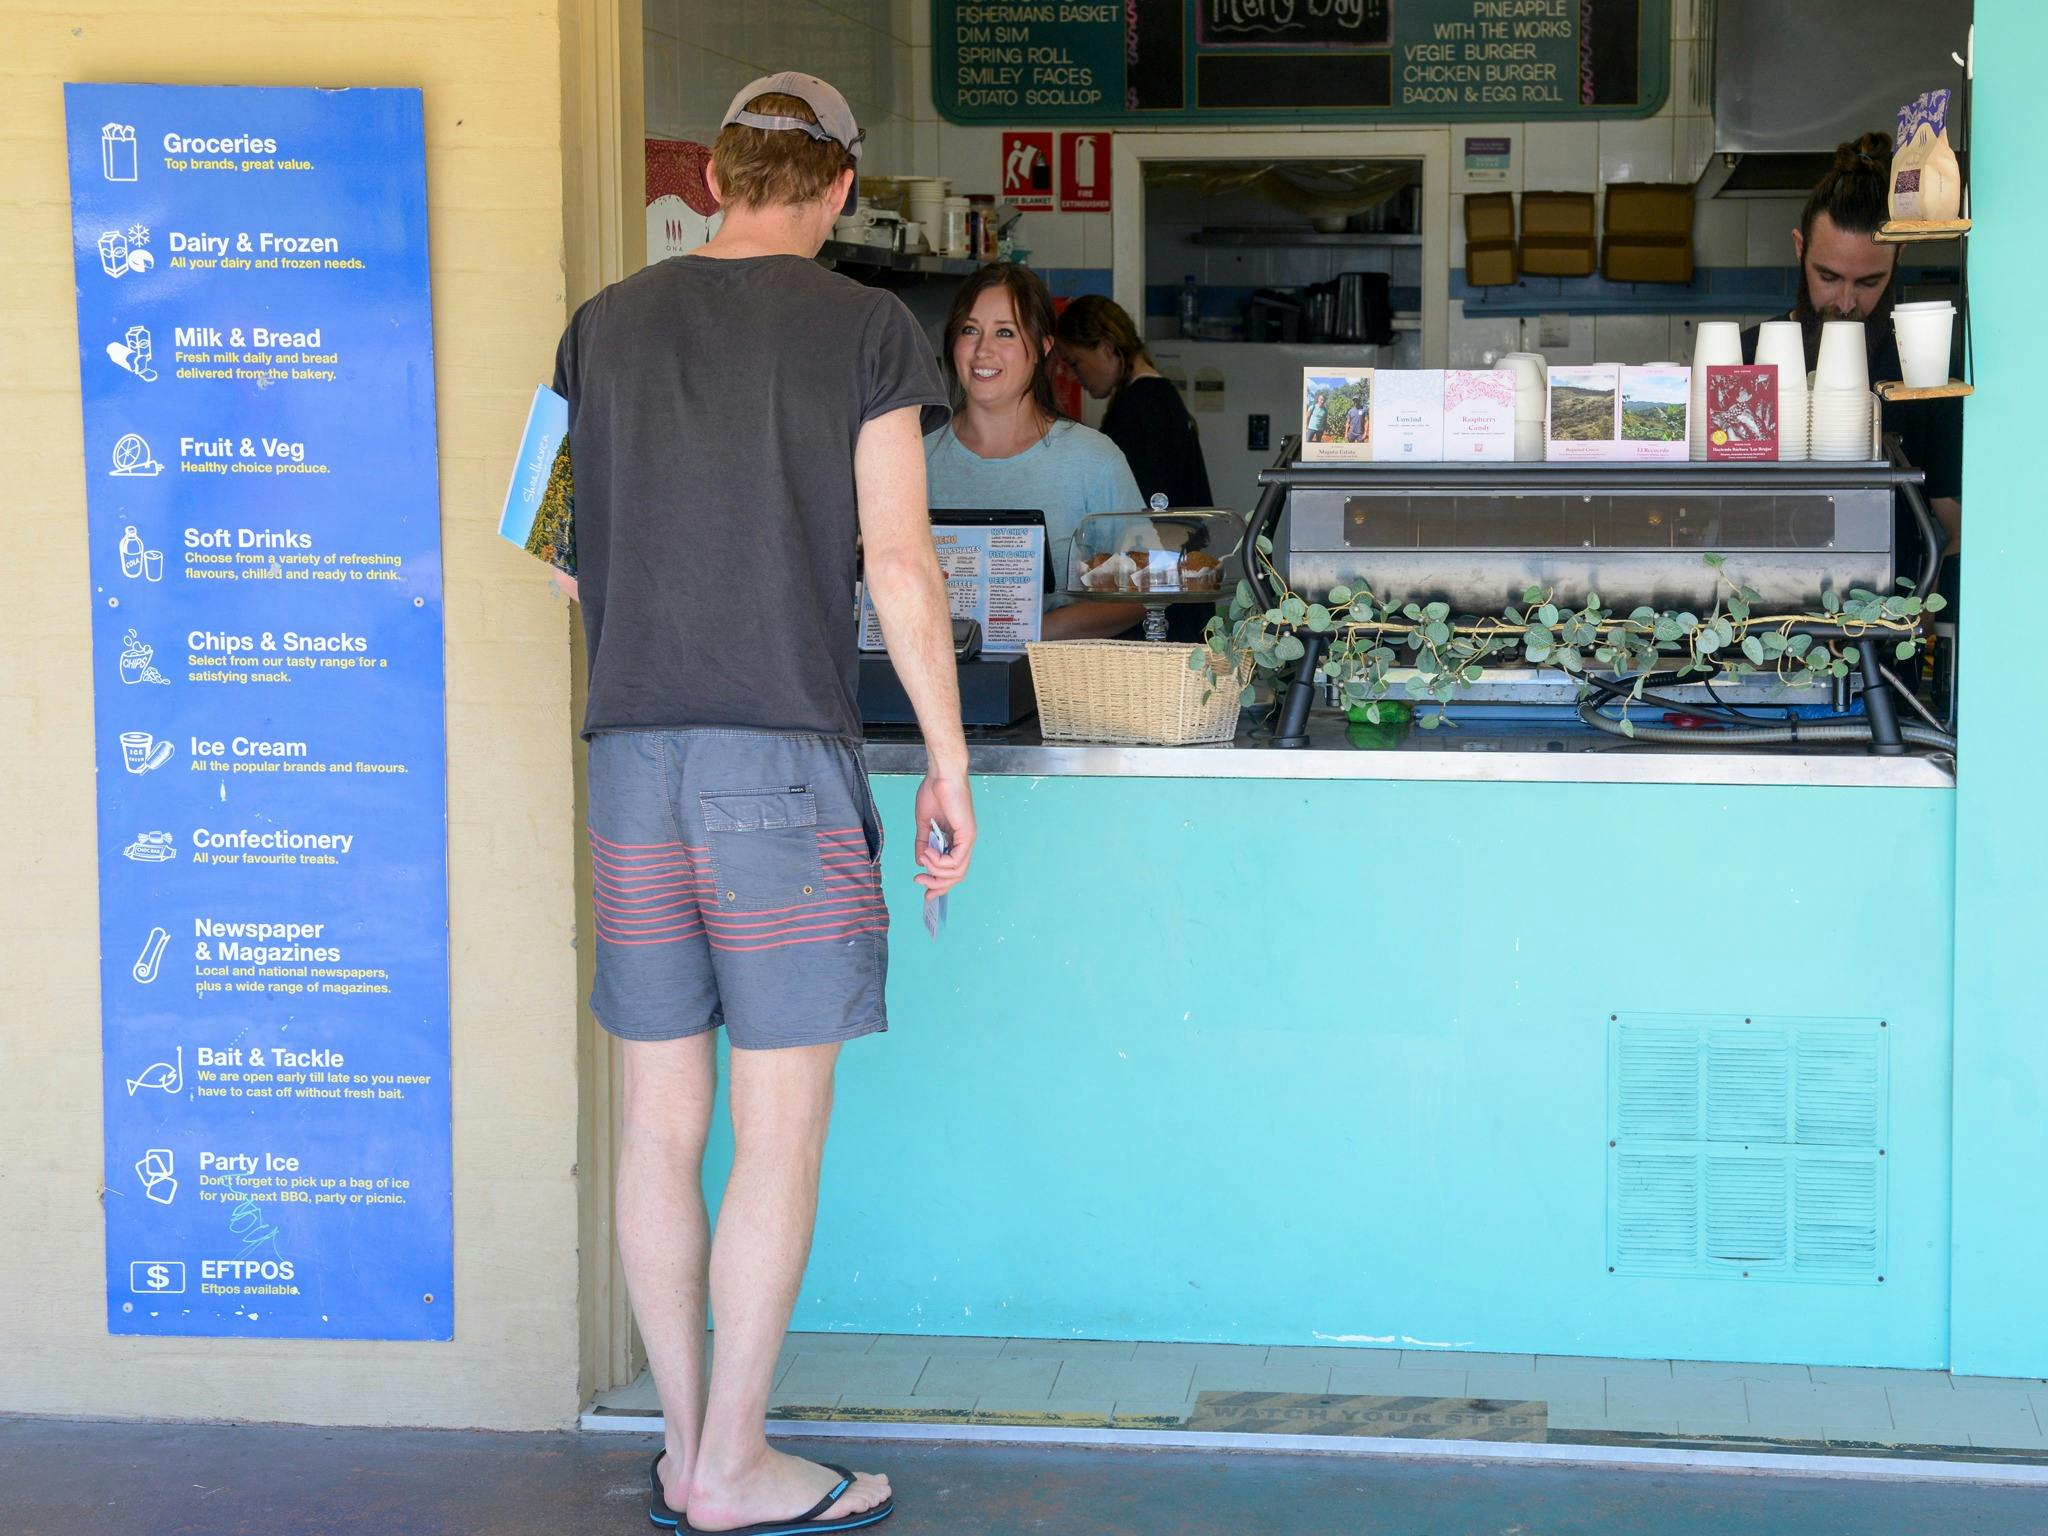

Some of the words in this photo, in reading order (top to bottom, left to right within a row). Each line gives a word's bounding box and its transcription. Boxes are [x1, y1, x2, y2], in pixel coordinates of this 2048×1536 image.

[956, 5, 1055, 23] FISHERMANS
[1059, 5, 1119, 22] BASKET
[1473, 1, 1567, 18] PINEAPPLE
[957, 27, 990, 43] DIM
[995, 27, 1029, 43] SIM
[1434, 22, 1475, 40] WITH
[1480, 22, 1509, 39] THE
[1514, 20, 1572, 38] WORKS
[958, 47, 1022, 64] SPRING
[1028, 47, 1073, 64] ROLL
[1404, 44, 1456, 62] VEGIE
[1464, 43, 1537, 60] BURGER
[958, 67, 1023, 85] SMILEY
[1033, 67, 1093, 86] FACES
[1403, 65, 1480, 83] CHICKEN
[1486, 64, 1557, 81] BURGER
[958, 89, 1018, 106] POTATO
[1026, 89, 1102, 105] SCOLLOP
[1403, 86, 1458, 104] BACON
[1464, 86, 1479, 102] &
[1482, 86, 1516, 102] EGG
[1522, 85, 1563, 101] ROLL
[163, 133, 277, 153] Groceries
[164, 158, 187, 171] Top
[191, 158, 238, 171] brands,
[241, 159, 274, 172] great
[277, 159, 314, 170] value.
[1062, 200, 1109, 208] EXTINGUISHER
[169, 232, 229, 256] Dairy
[236, 232, 253, 252] &
[260, 233, 338, 253] Frozen
[170, 257, 188, 268] All
[189, 259, 217, 270] your
[220, 257, 251, 270] dairy
[255, 257, 278, 268] and
[281, 257, 321, 268] frozen
[324, 258, 365, 269] needs.
[175, 327, 223, 347] Milk
[230, 328, 246, 347] &
[253, 328, 320, 347] Bread
[176, 352, 210, 363] Fresh
[214, 352, 239, 362] milk
[243, 353, 272, 365] daily
[276, 353, 298, 363] and
[302, 353, 337, 364] bread
[176, 368, 233, 379] delivered
[236, 368, 264, 379] from
[268, 368, 288, 380] the
[292, 368, 336, 382] bakery.
[180, 437, 233, 457] Fruit
[240, 438, 256, 457] &
[261, 438, 304, 461] Veg
[181, 461, 228, 474] Healthy
[231, 462, 272, 473] choice
[276, 463, 330, 475] produce.
[184, 528, 231, 548] Soft
[238, 529, 312, 548] Drinks
[185, 552, 232, 563] Choose
[236, 553, 264, 563] from
[269, 555, 276, 564] a
[279, 554, 320, 567] variety
[324, 554, 336, 564] of
[339, 554, 401, 567] refreshing
[185, 568, 238, 580] flavours,
[242, 568, 282, 579] chilled
[286, 569, 309, 579] and
[312, 569, 347, 582] ready
[349, 570, 363, 580] to
[366, 569, 401, 580] drink.
[188, 631, 253, 654] Chips
[260, 632, 277, 651] &
[283, 632, 367, 652] Snacks
[122, 657, 147, 670] CHIPS
[188, 654, 227, 666] Select
[230, 655, 259, 666] from
[263, 658, 283, 667] our
[286, 657, 316, 669] tasty
[320, 658, 358, 670] range
[359, 657, 376, 667] for
[380, 659, 387, 668] a
[189, 671, 247, 684] satisfying
[251, 672, 291, 682] snack.
[191, 737, 225, 756] Ice
[232, 737, 307, 756] Cream
[191, 760, 206, 771] All
[210, 760, 230, 771] the
[233, 761, 280, 773] popular
[283, 761, 326, 772] brands
[329, 762, 352, 772] and
[355, 762, 408, 773] flavours.
[193, 828, 353, 853] Confectionery
[193, 852, 208, 863] All
[212, 854, 239, 865] your
[242, 853, 296, 864] favourite
[300, 854, 338, 864] treats.
[195, 918, 324, 941] Newspaper
[195, 942, 212, 961] &
[219, 942, 340, 965] Magazines
[196, 965, 229, 975] Local
[233, 966, 255, 976] and
[259, 966, 307, 976] national
[311, 967, 389, 980] newspapers,
[198, 1048, 242, 1066] Bait
[249, 1048, 265, 1066] &
[271, 1048, 344, 1067] Tackle
[198, 1071, 216, 1081] We
[220, 1073, 239, 1081] are
[243, 1074, 273, 1083] open
[277, 1072, 306, 1084] early
[310, 1072, 324, 1082] till
[328, 1072, 350, 1083] late
[353, 1075, 368, 1083] so
[371, 1075, 394, 1085] you
[397, 1075, 431, 1084] never
[200, 1152, 259, 1174] Party
[266, 1153, 299, 1171] Ice
[200, 1175, 233, 1186] Don't
[236, 1176, 272, 1188] forget
[275, 1177, 288, 1186] to
[291, 1177, 317, 1188] pick
[321, 1179, 336, 1189] up
[339, 1179, 346, 1187] a
[350, 1177, 373, 1190] bag
[376, 1178, 389, 1188] of
[392, 1178, 410, 1188] ice
[202, 1260, 294, 1280] EFTPOS
[1213, 1405, 1328, 1421] WATCH
[1342, 1409, 1432, 1425] YOUR
[1444, 1412, 1533, 1428] STEP
